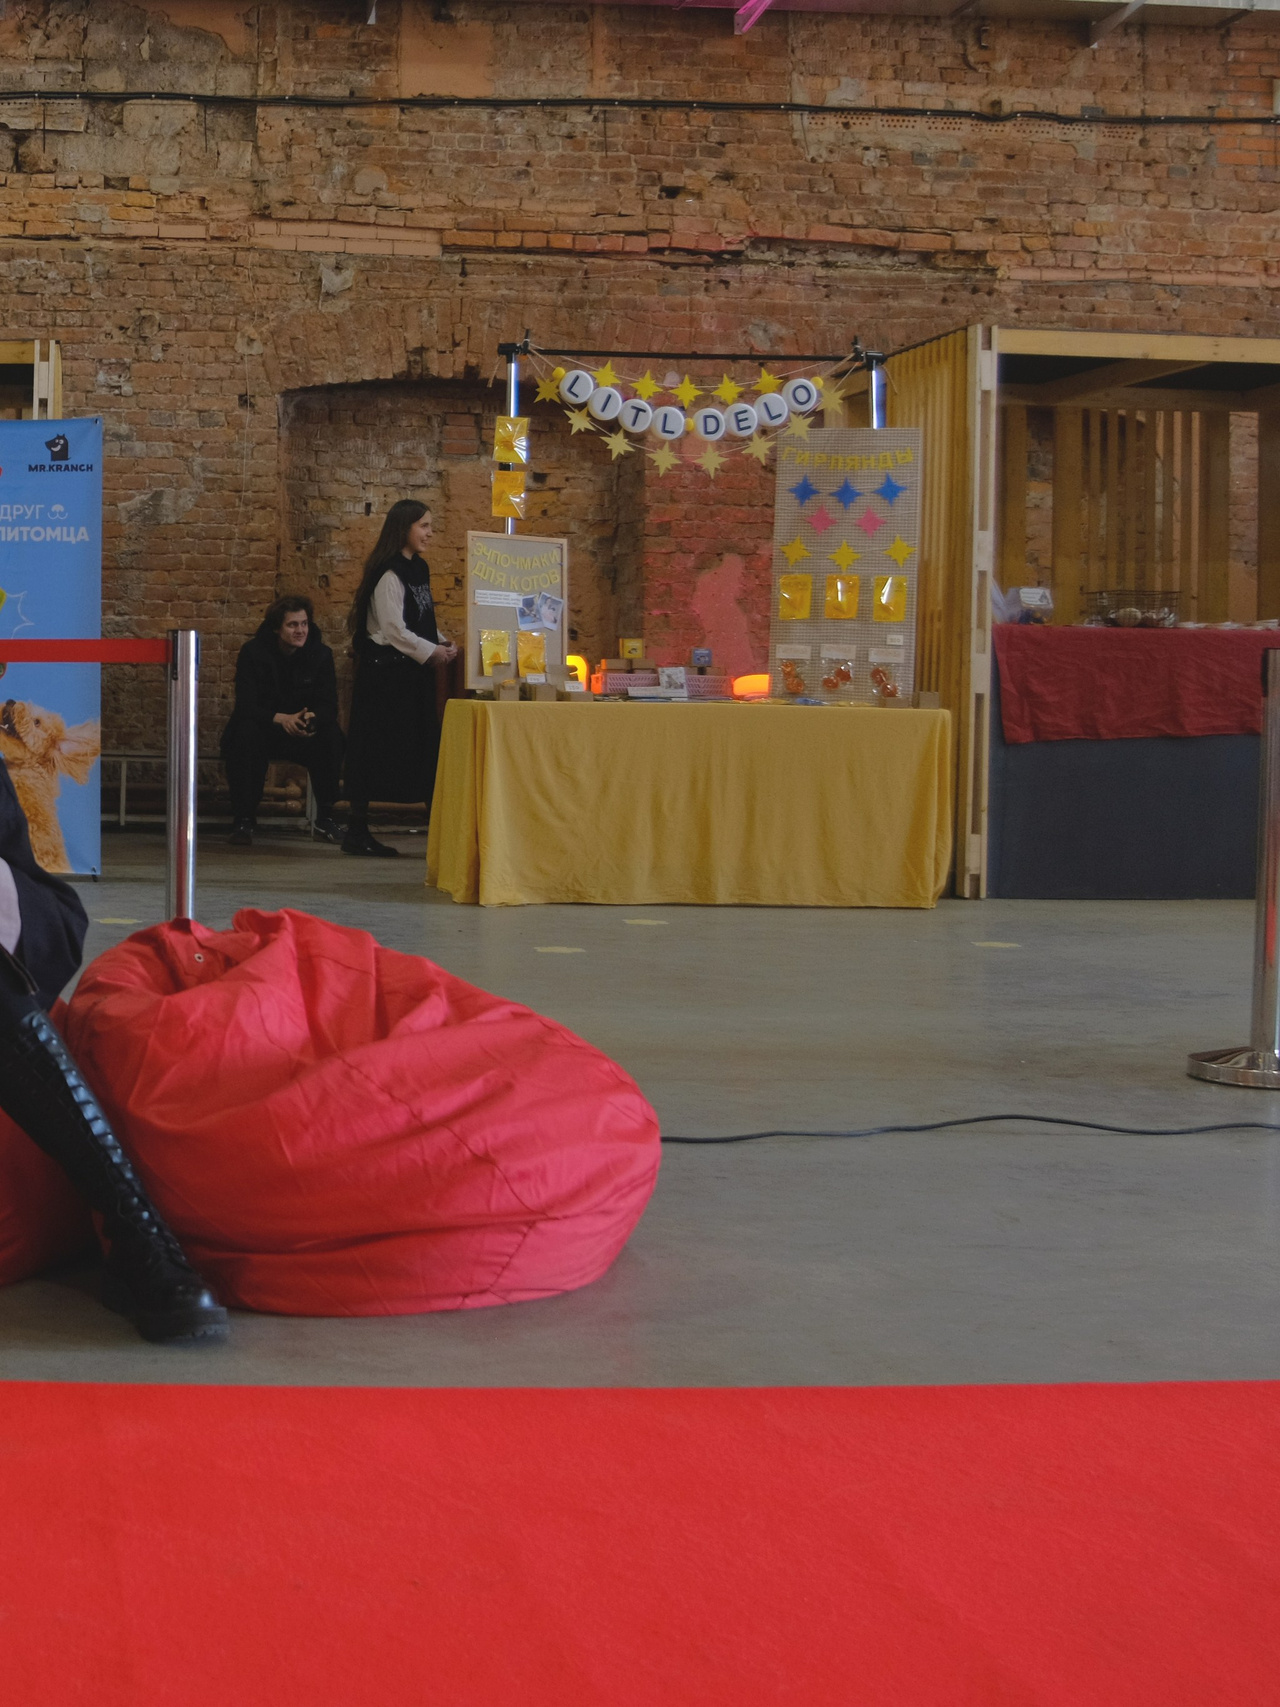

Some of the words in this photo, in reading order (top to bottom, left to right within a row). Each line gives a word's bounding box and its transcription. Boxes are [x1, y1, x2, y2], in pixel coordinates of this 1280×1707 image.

[565, 373, 677, 435] LITL
[702, 383, 813, 436] DELO
[28, 464, 94, 473] MR.KRANCH
[473, 542, 560, 571] ЭЧПОЧМАКИ
[509, 568, 561, 592] КОТОВ
